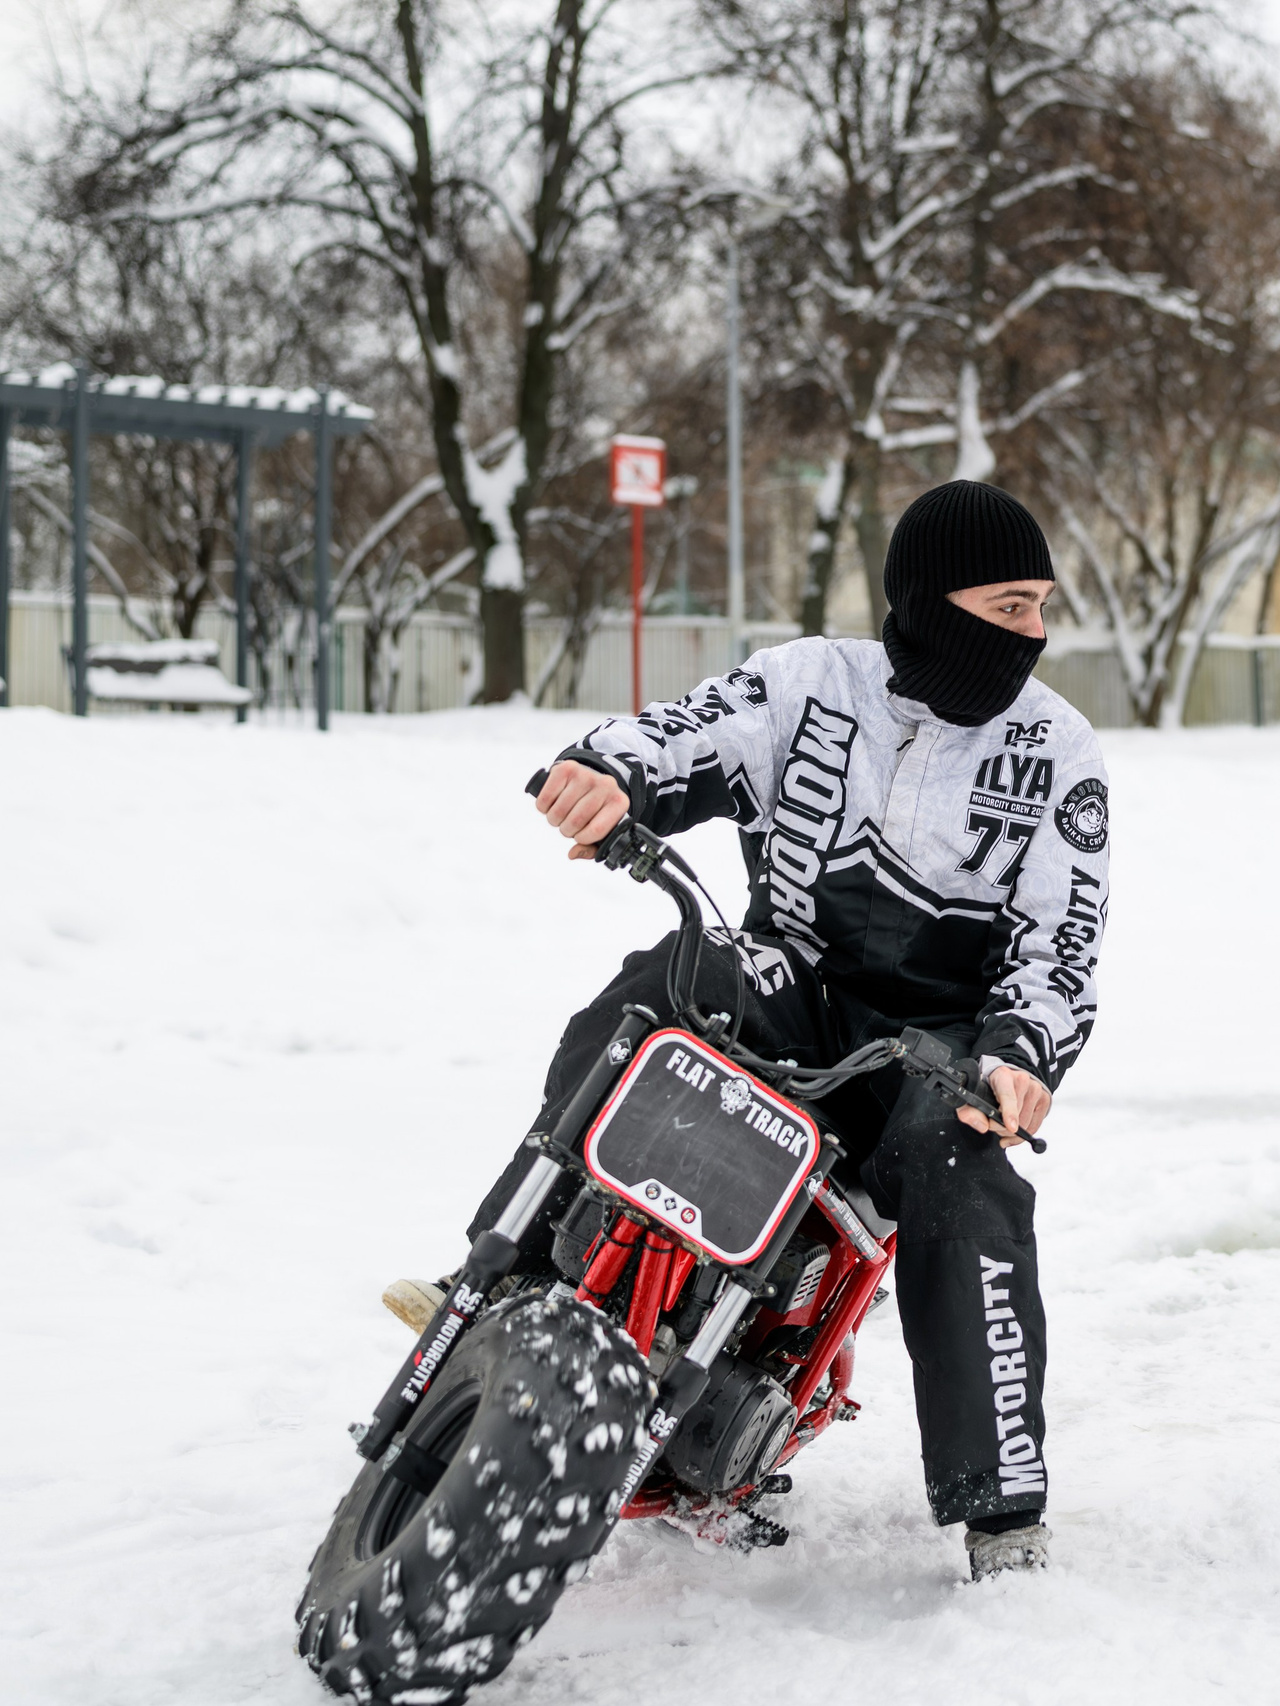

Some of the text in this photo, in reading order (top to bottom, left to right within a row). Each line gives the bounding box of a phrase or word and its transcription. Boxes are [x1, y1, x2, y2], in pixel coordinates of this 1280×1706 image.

[971, 793, 1009, 811] MOTORCITY
[1010, 803, 1031, 815] CREW
[972, 751, 1056, 804] ILYA
[954, 808, 1040, 889] 77
[1061, 817, 1105, 847] BAIKAL CREW
[665, 1048, 809, 1158] FLAT TRACK
[979, 1253, 1047, 1498] MOTORCITY
[617, 1437, 659, 1514] MOTORC
